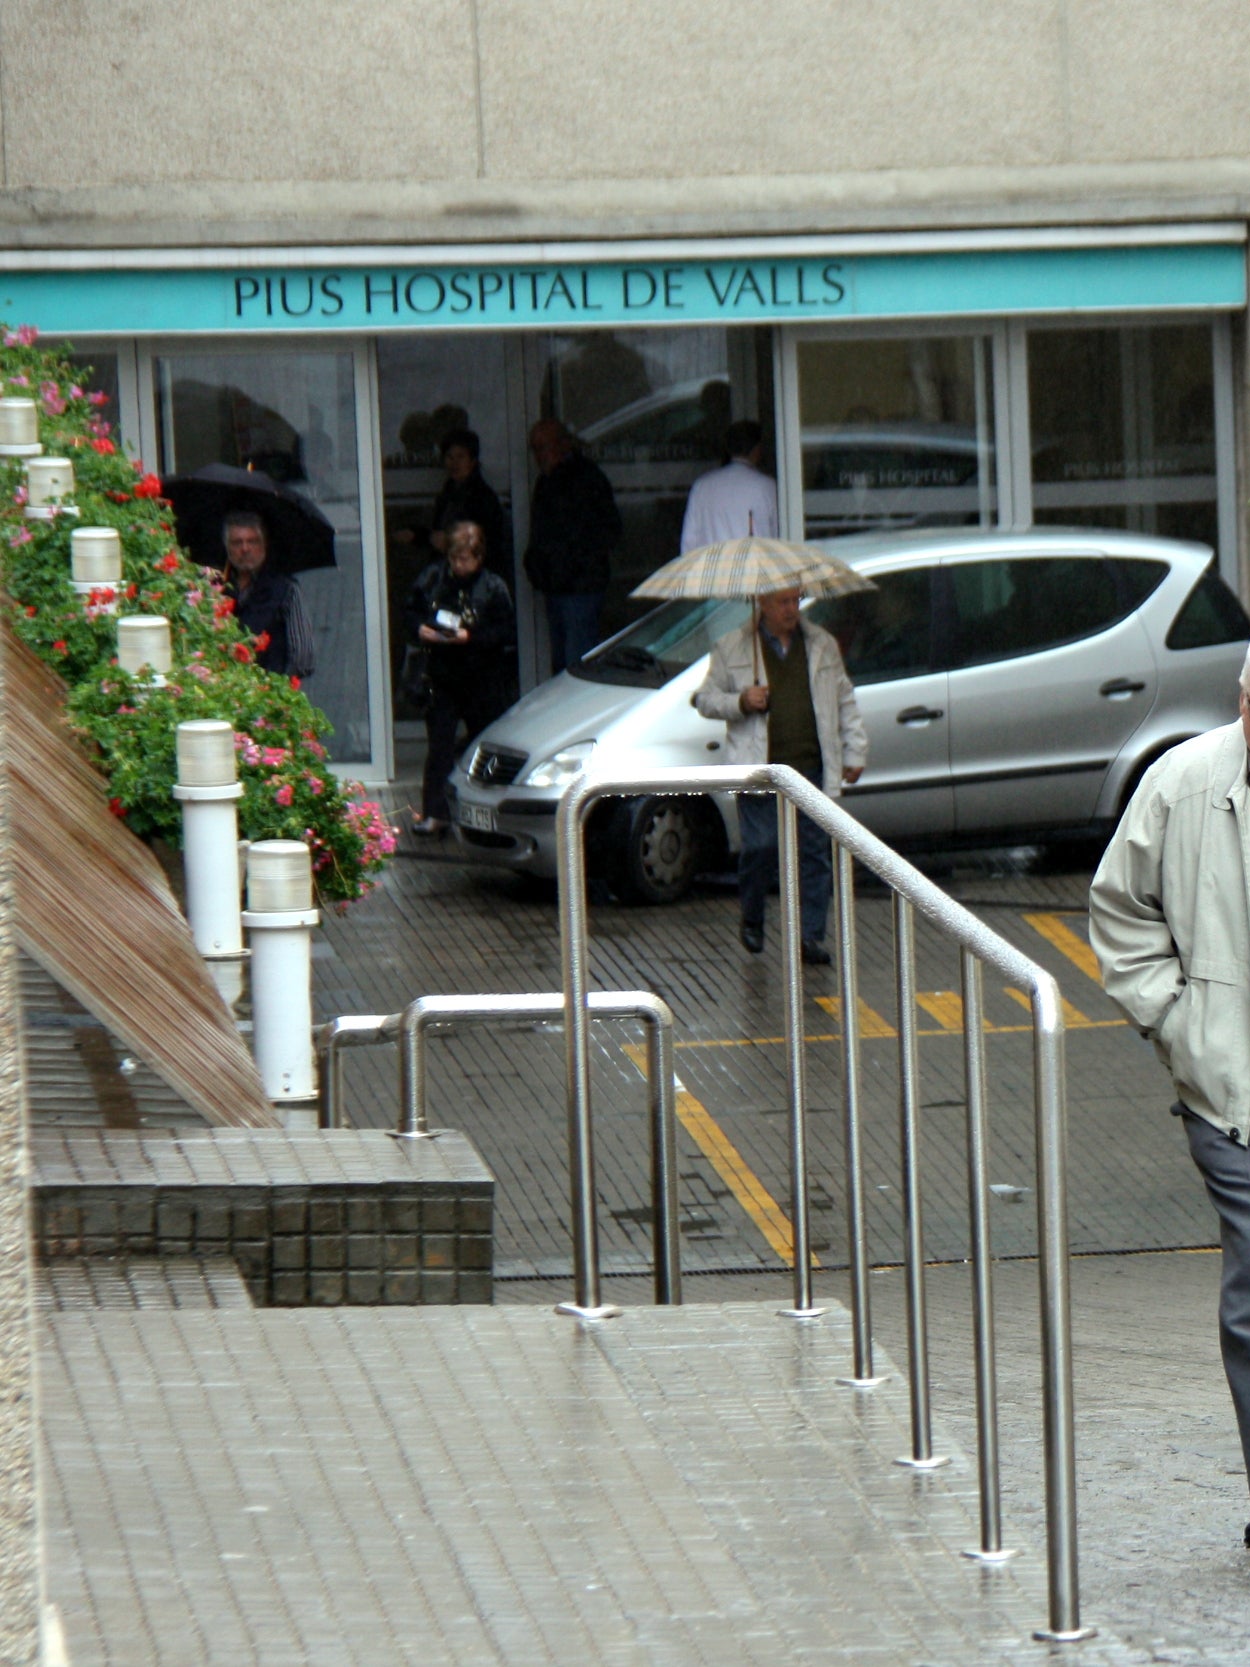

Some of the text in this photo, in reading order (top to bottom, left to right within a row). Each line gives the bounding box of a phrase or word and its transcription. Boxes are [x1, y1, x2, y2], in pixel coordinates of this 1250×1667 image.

[234, 263, 846, 317] PIUS HOSPITAL DE VALLS
